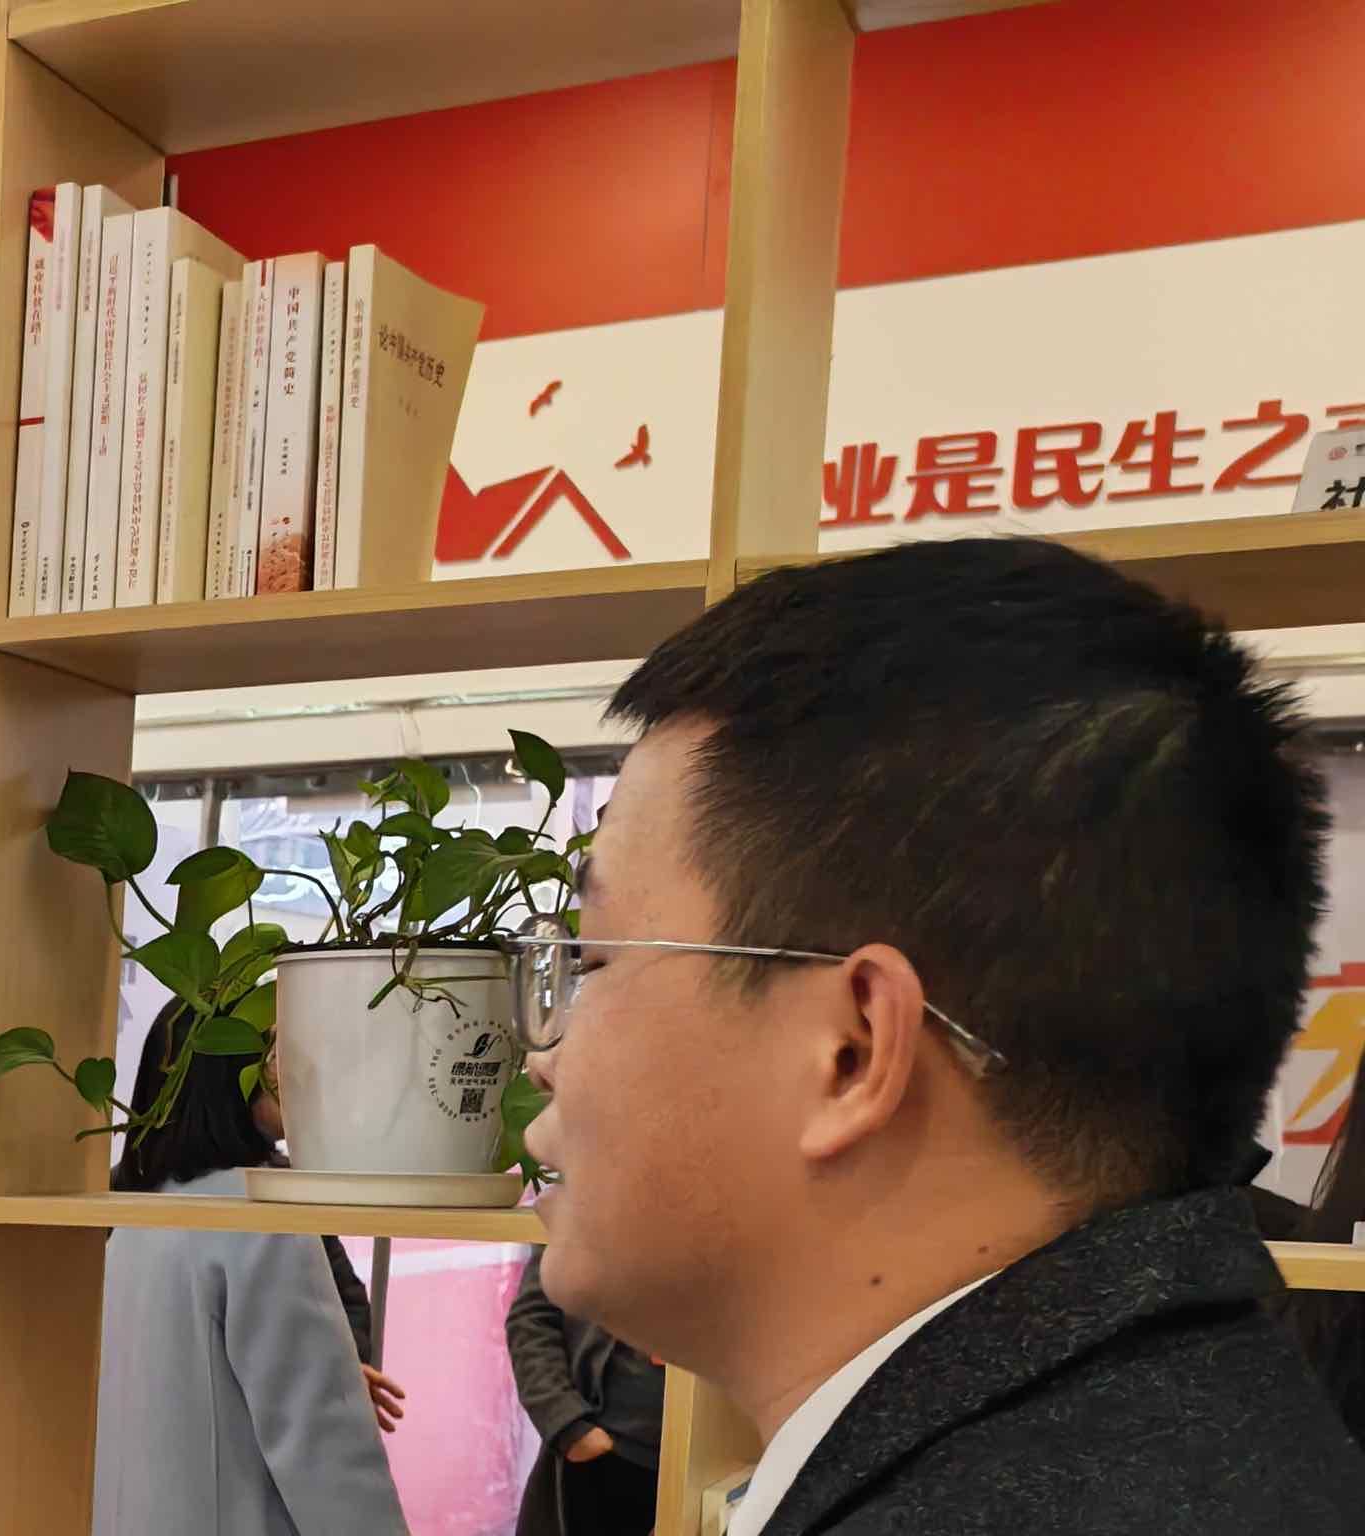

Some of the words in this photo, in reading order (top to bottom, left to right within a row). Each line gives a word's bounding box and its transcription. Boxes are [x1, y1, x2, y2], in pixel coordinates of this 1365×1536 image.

[283, 287, 300, 396] 中国共产党简史
